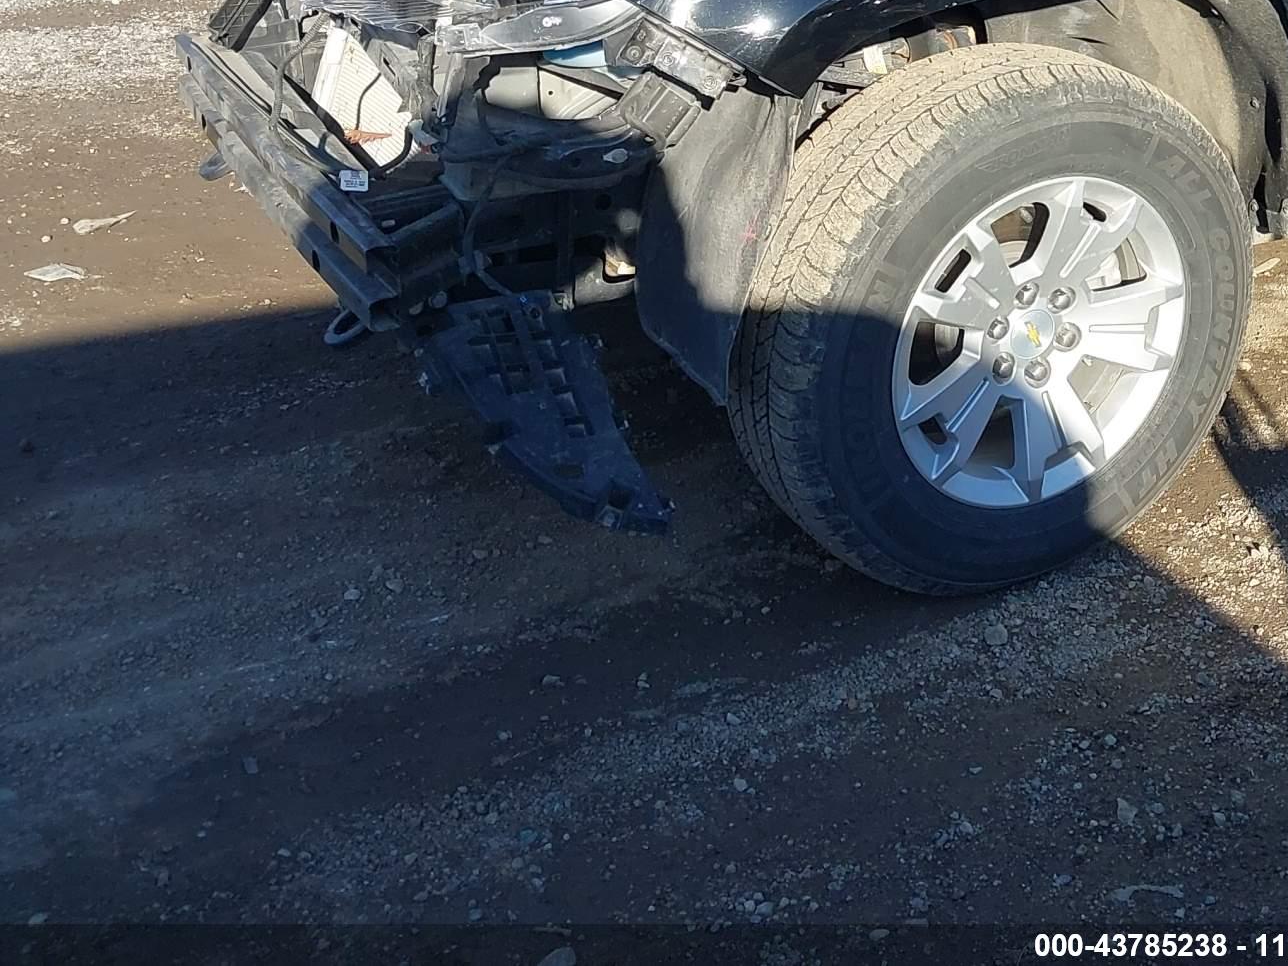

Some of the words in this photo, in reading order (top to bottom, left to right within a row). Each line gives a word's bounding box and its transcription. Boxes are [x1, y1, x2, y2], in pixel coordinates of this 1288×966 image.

[1152, 154, 1212, 210] ALL
[1191, 228, 1235, 430] COUNTRY
[1137, 436, 1179, 498] HT
